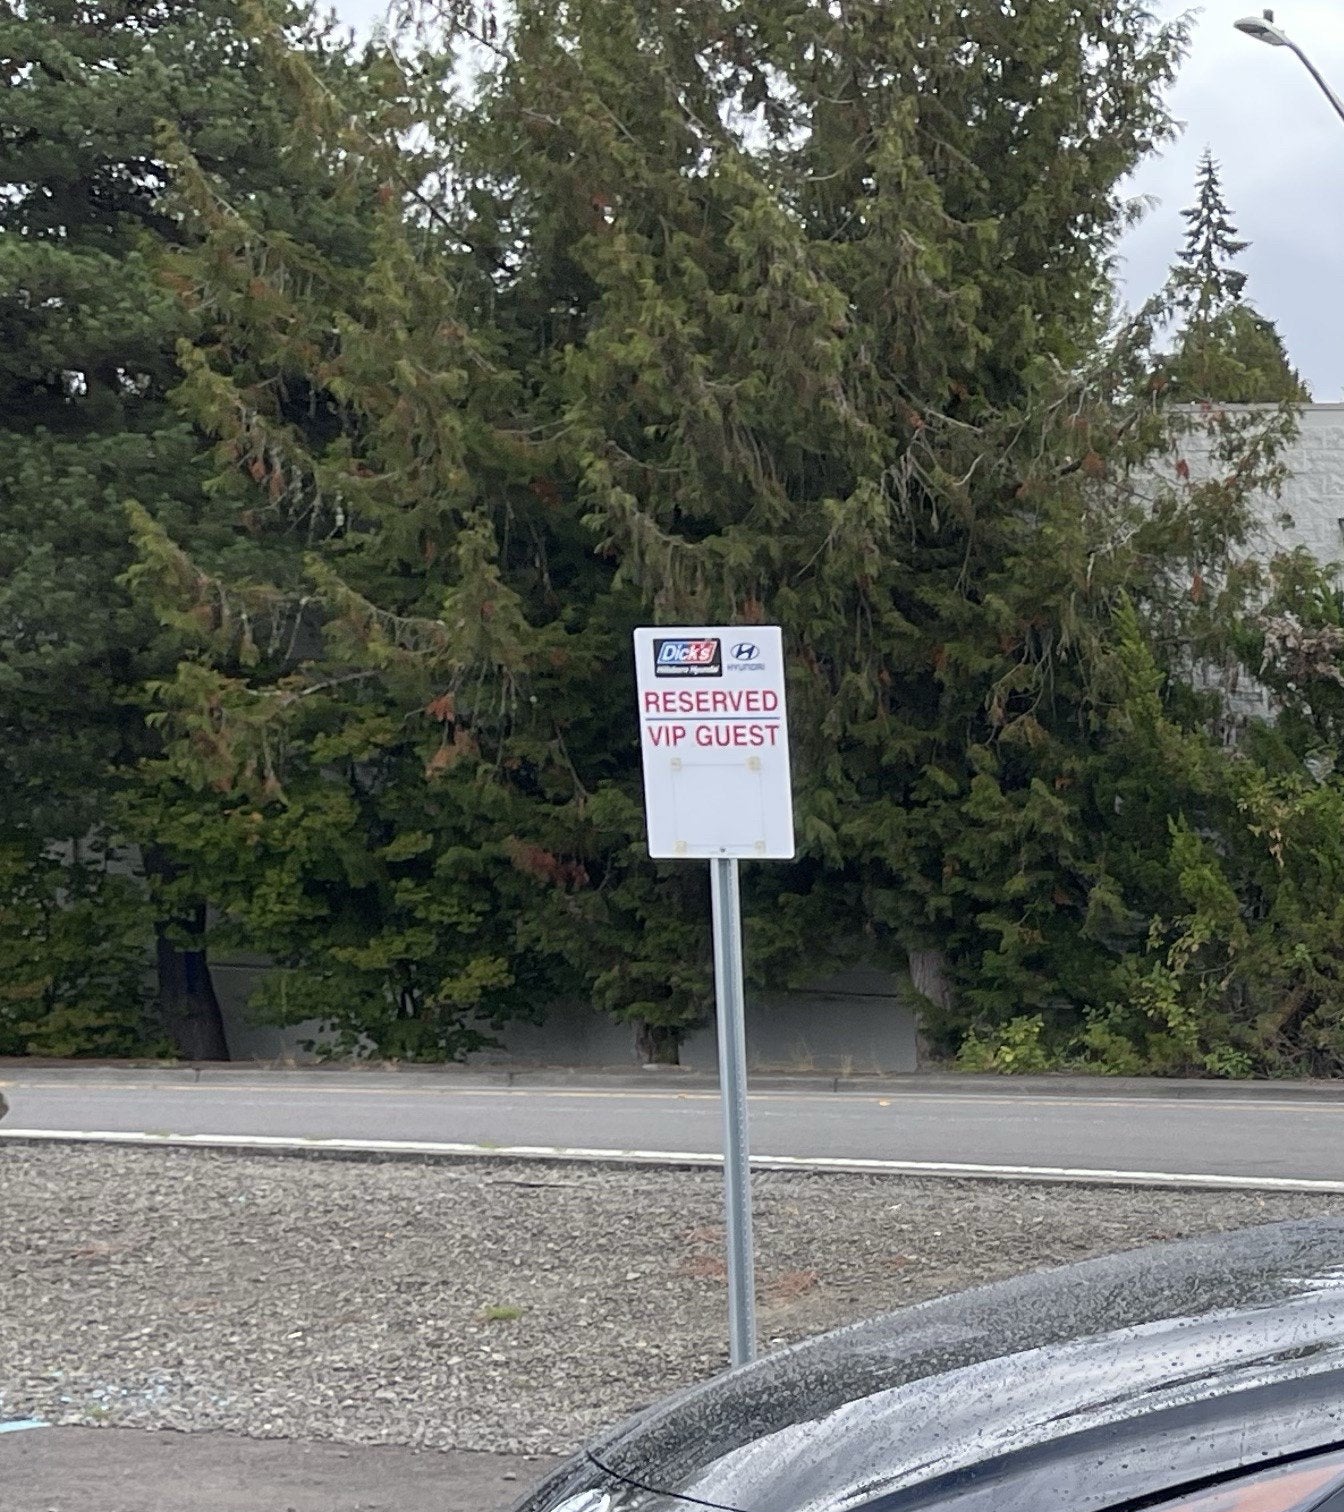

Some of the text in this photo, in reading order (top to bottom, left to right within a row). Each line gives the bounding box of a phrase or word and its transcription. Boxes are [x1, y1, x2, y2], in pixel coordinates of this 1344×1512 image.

[660, 643, 710, 661] Dick's
[645, 690, 778, 713] RESERVED
[648, 725, 779, 747] VIP GUEST
